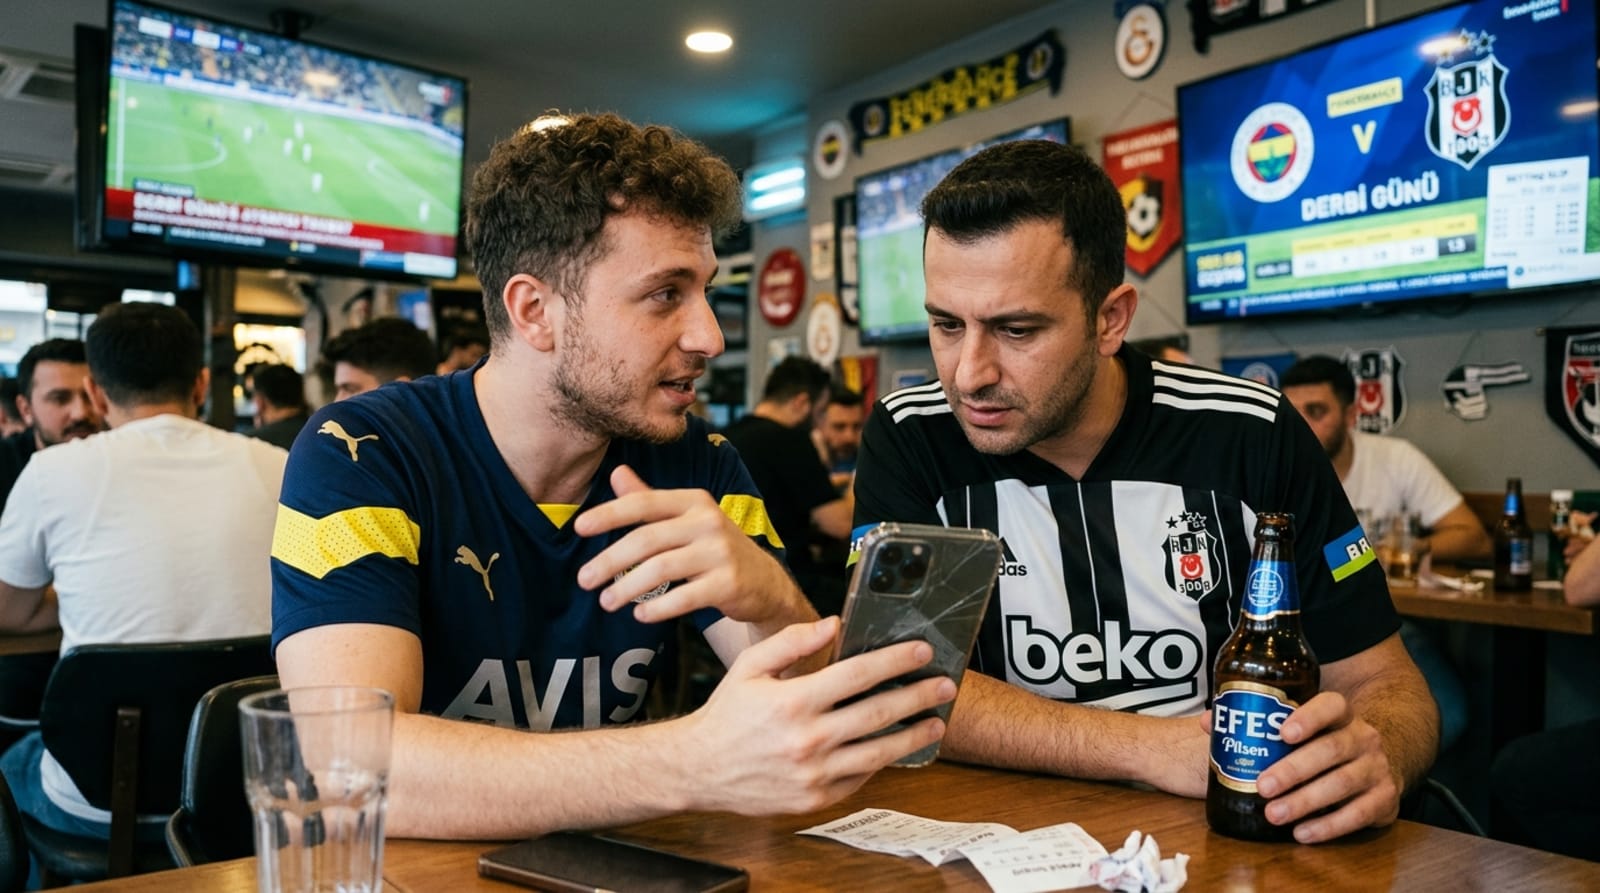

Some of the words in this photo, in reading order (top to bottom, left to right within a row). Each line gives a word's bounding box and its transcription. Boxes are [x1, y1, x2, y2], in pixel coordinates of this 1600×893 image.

[1352, 120, 1377, 155] V
[1301, 183, 1367, 222] DERBİ
[1371, 170, 1440, 210] GÜNÜ
[1009, 619, 1199, 684] beko
[440, 648, 656, 732] AVIS
[1214, 704, 1289, 741] EFES
